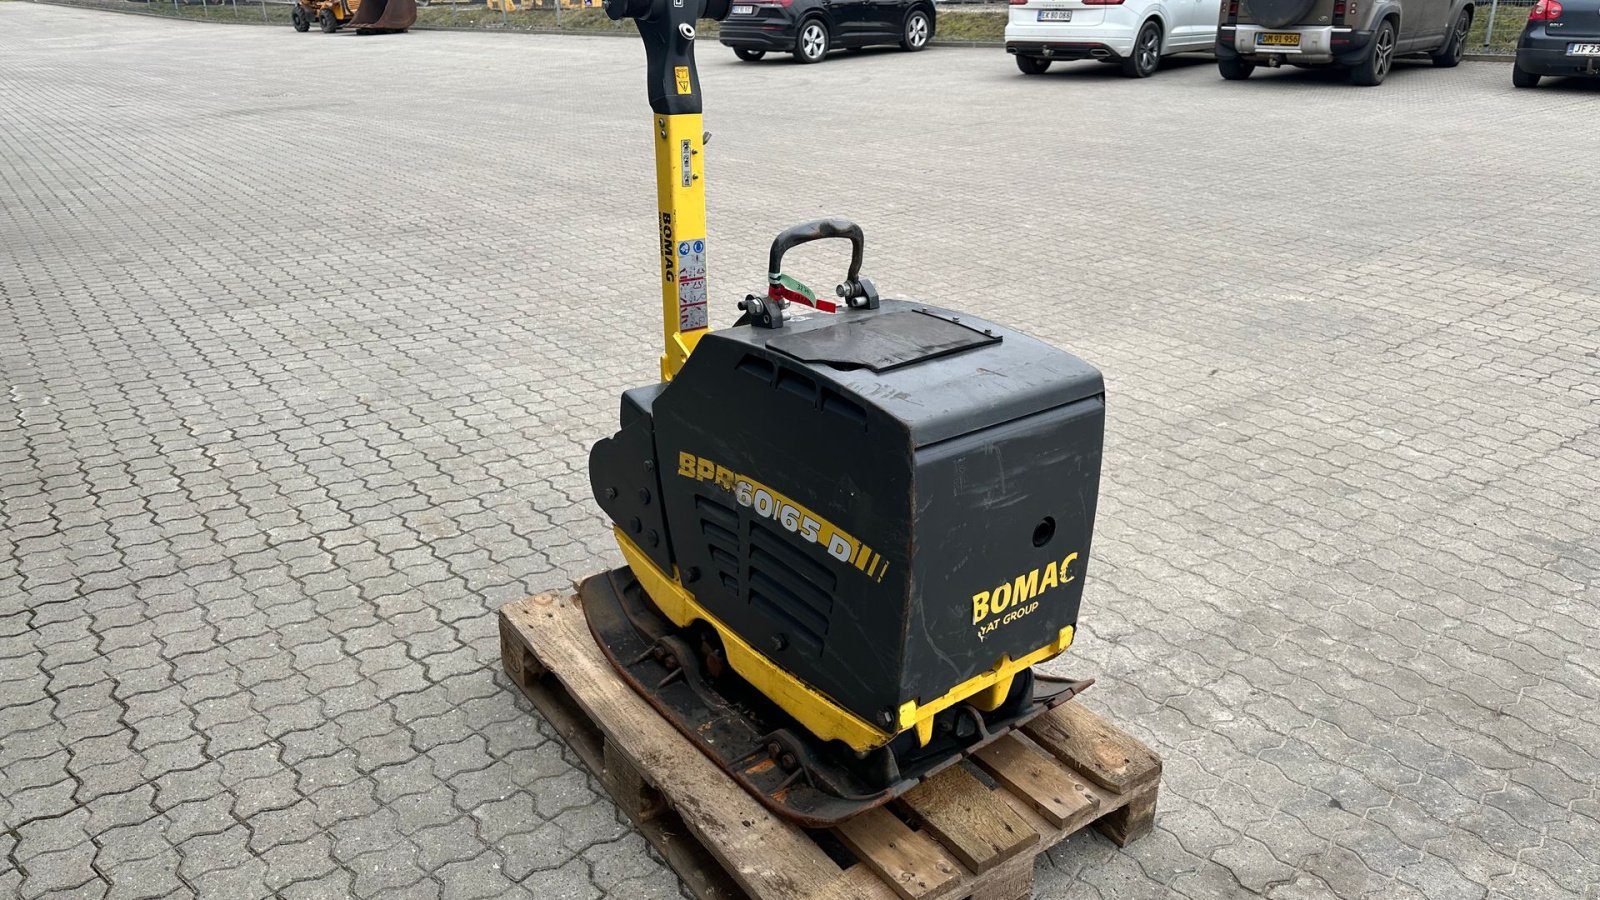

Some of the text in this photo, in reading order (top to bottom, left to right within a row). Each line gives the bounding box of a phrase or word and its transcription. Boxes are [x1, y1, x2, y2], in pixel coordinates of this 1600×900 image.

[1575, 45, 1588, 53] JF
[663, 212, 675, 283] BOMAG
[827, 532, 852, 563] D
[1002, 601, 1039, 625] GROUP
